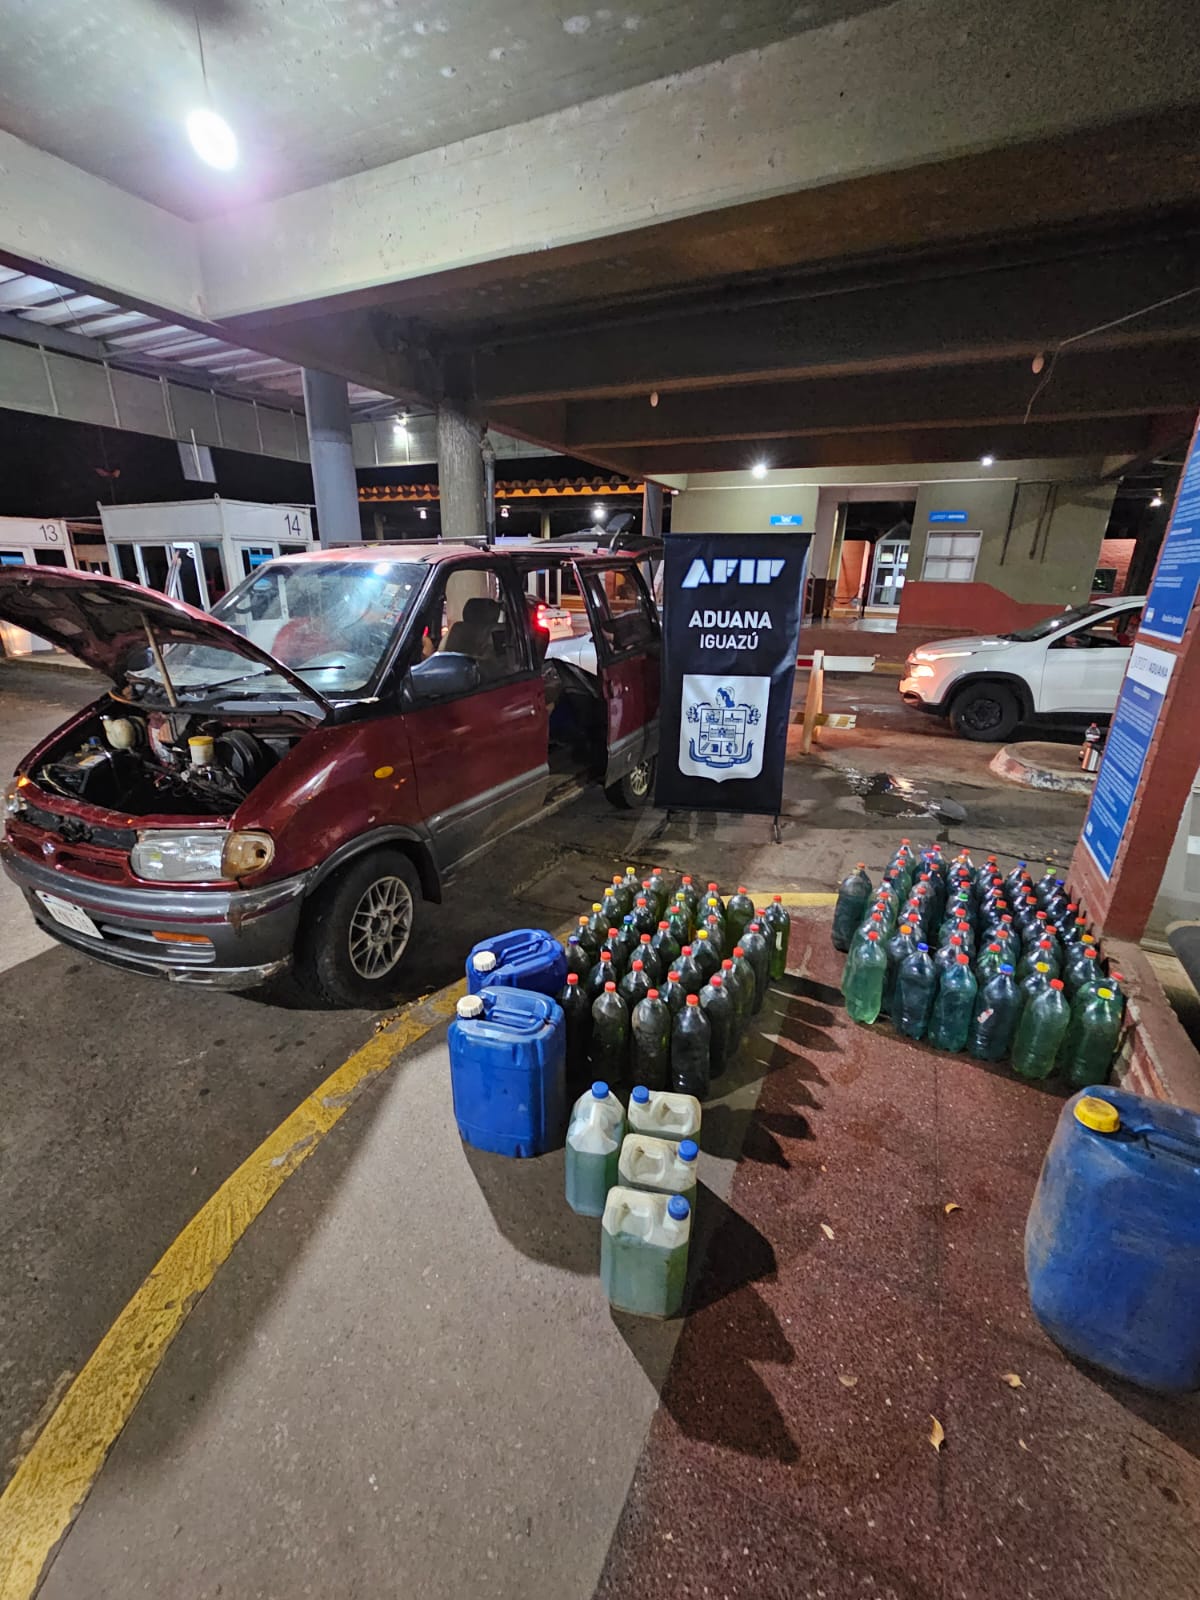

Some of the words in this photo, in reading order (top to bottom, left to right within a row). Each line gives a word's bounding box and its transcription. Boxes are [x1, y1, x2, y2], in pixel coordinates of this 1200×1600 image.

[40, 524, 58, 541] 13
[284, 513, 301, 536] 14
[681, 558, 786, 589] AFIP
[688, 609, 773, 629] ADUANA
[700, 631, 759, 650] IGUAZÚ
